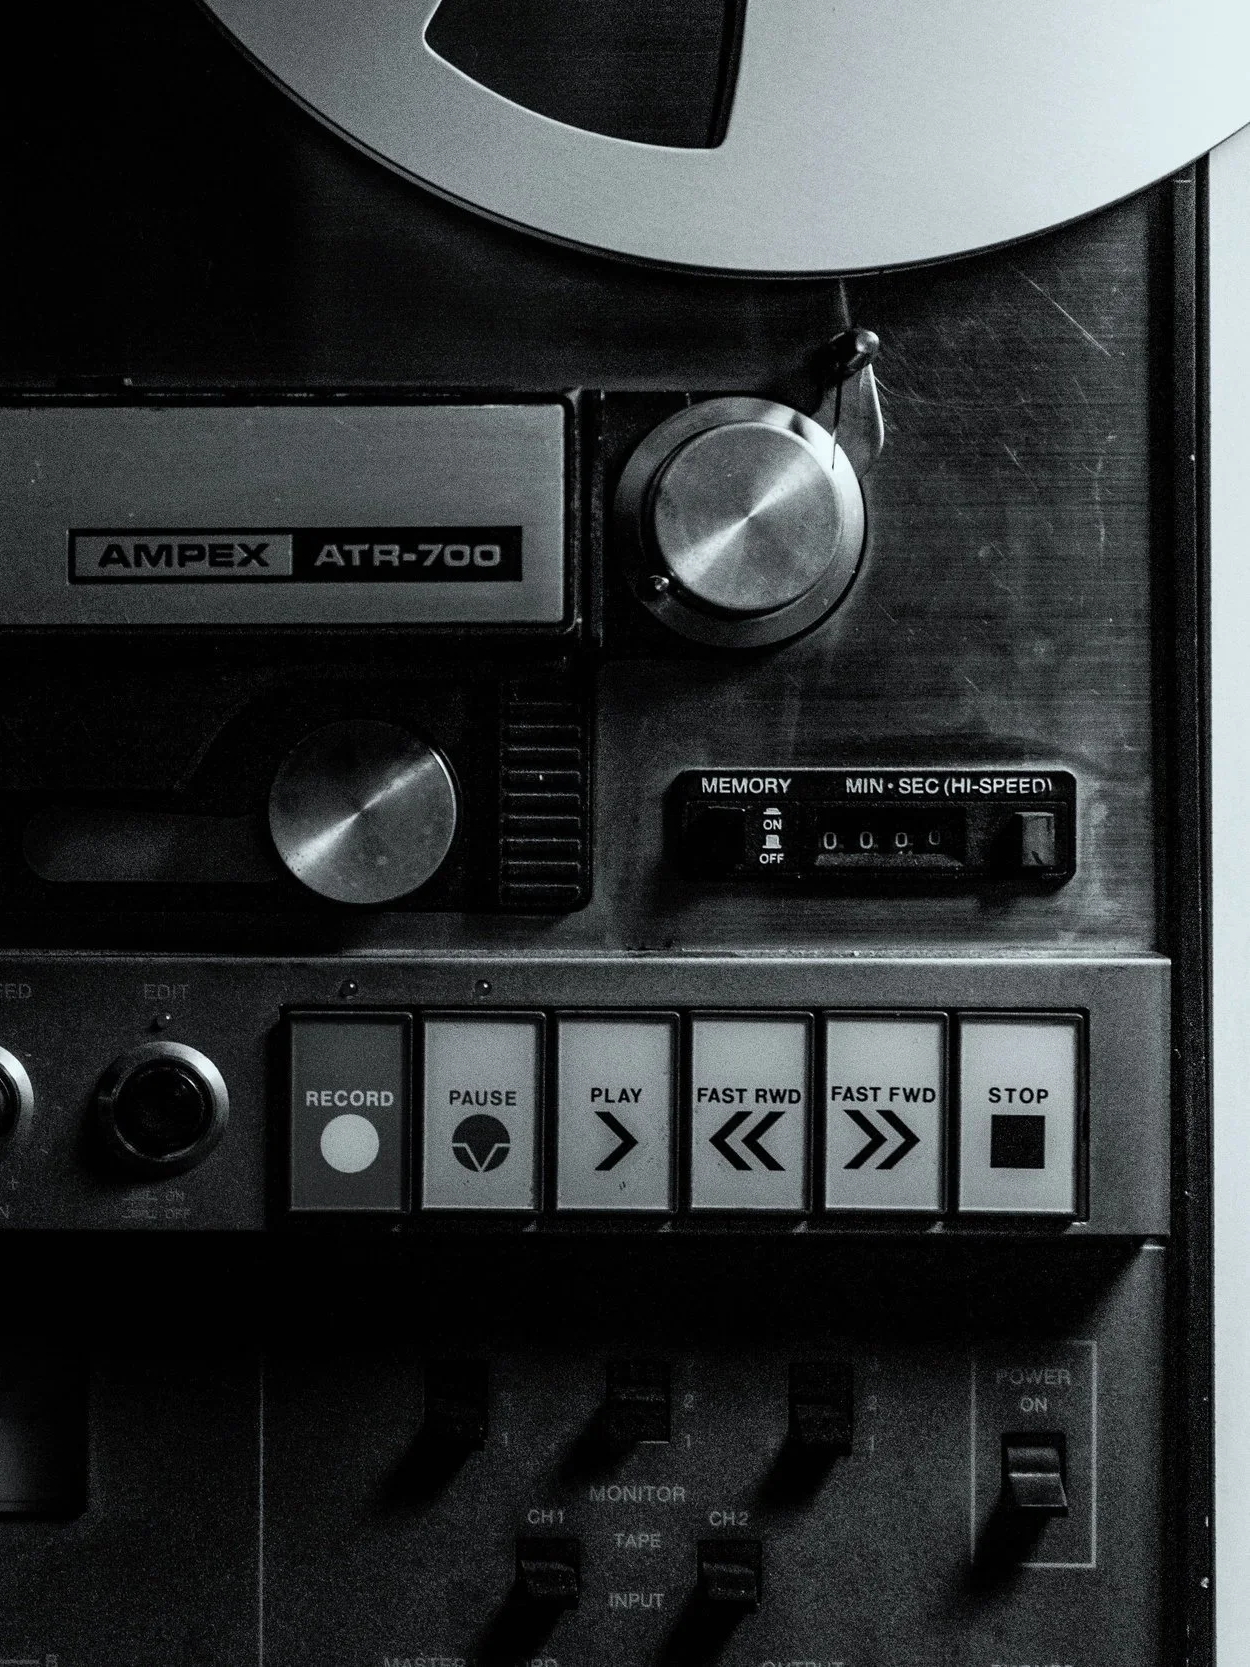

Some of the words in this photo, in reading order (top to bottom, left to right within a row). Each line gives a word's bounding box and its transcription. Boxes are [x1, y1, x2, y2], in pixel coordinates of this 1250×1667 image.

[98, 543, 269, 568] AMPEX
[313, 543, 502, 567] ATR-700
[701, 777, 792, 795] MEMORY
[762, 818, 783, 831] ON
[758, 853, 784, 865] OFF
[143, 983, 189, 1000] EDIT
[305, 1090, 394, 1107] RECORD
[449, 1089, 518, 1107] PAUSE
[590, 1087, 642, 1104] PLAY
[696, 1087, 748, 1104] FAST
[754, 1088, 802, 1105] RWD
[830, 1086, 881, 1104] FAST
[888, 1087, 936, 1104] FWD
[988, 1087, 1050, 1104] STOP
[996, 1368, 1072, 1386] POWER
[1019, 1396, 1048, 1412] ON
[588, 1486, 687, 1503] MONITOR
[526, 1509, 566, 1526] CH1
[707, 1511, 750, 1528] CH2
[613, 1533, 662, 1549] TAPE
[608, 1592, 665, 1609] INPUT
